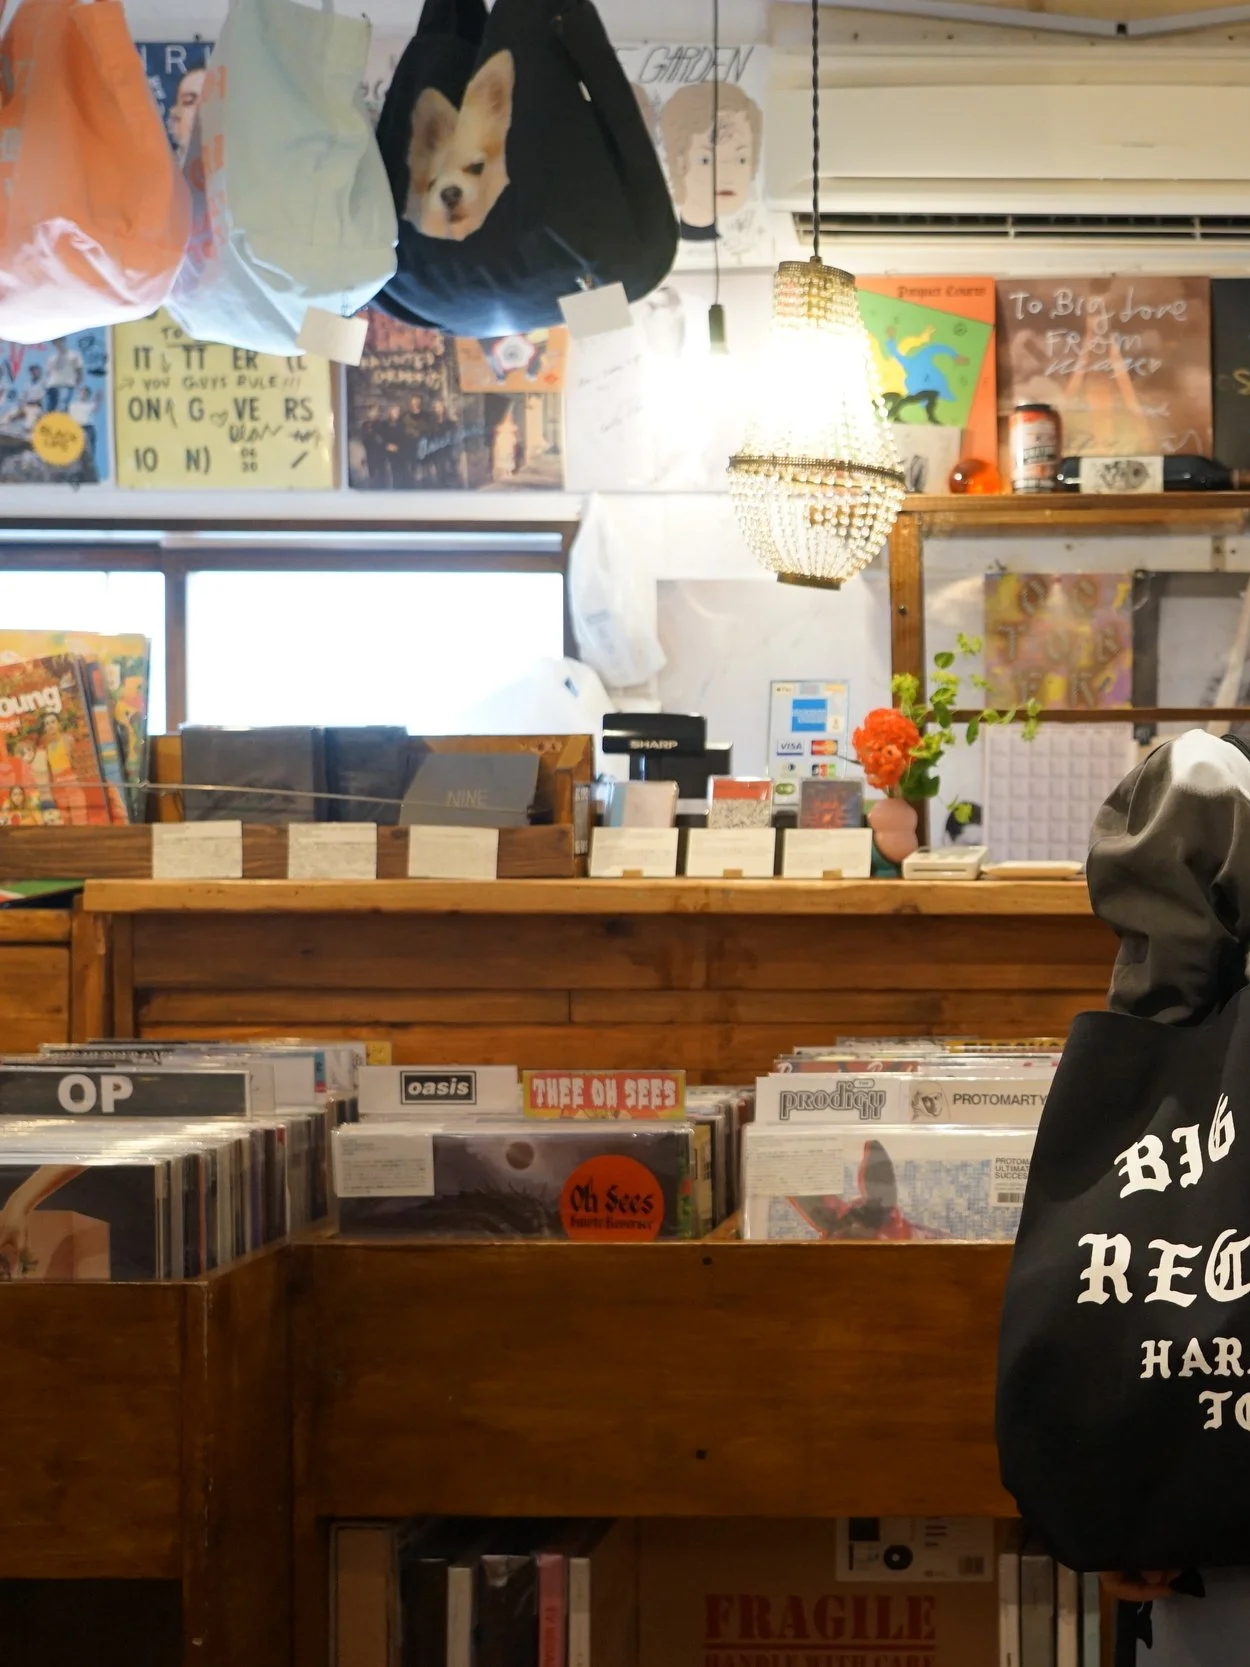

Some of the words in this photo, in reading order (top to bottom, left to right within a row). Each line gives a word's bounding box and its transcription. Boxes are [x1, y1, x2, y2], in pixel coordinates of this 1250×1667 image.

[639, 46, 755, 84] GARDEN
[133, 346, 153, 371] IT
[143, 377, 171, 390] YOU
[182, 375, 228, 390] GUYS
[236, 374, 278, 390] RULE
[127, 397, 161, 422] ON
[188, 397, 205, 422] G
[234, 396, 261, 421] VE
[284, 396, 314, 422] RS
[629, 739, 678, 750] SHARP
[446, 789, 489, 808] NINE
[57, 1073, 134, 1114] OP
[407, 1078, 470, 1095] oasis
[532, 1077, 584, 1109] THEE
[591, 1078, 618, 1108] OH
[624, 1078, 676, 1110] SEES
[779, 1079, 887, 1121] prodigy
[1114, 1093, 1236, 1199] BIG
[995, 1157, 1031, 1165] PROTOM
[569, 1175, 599, 1215] Oh
[605, 1184, 654, 1215] Sees
[704, 1593, 936, 1640] FRAGILE
